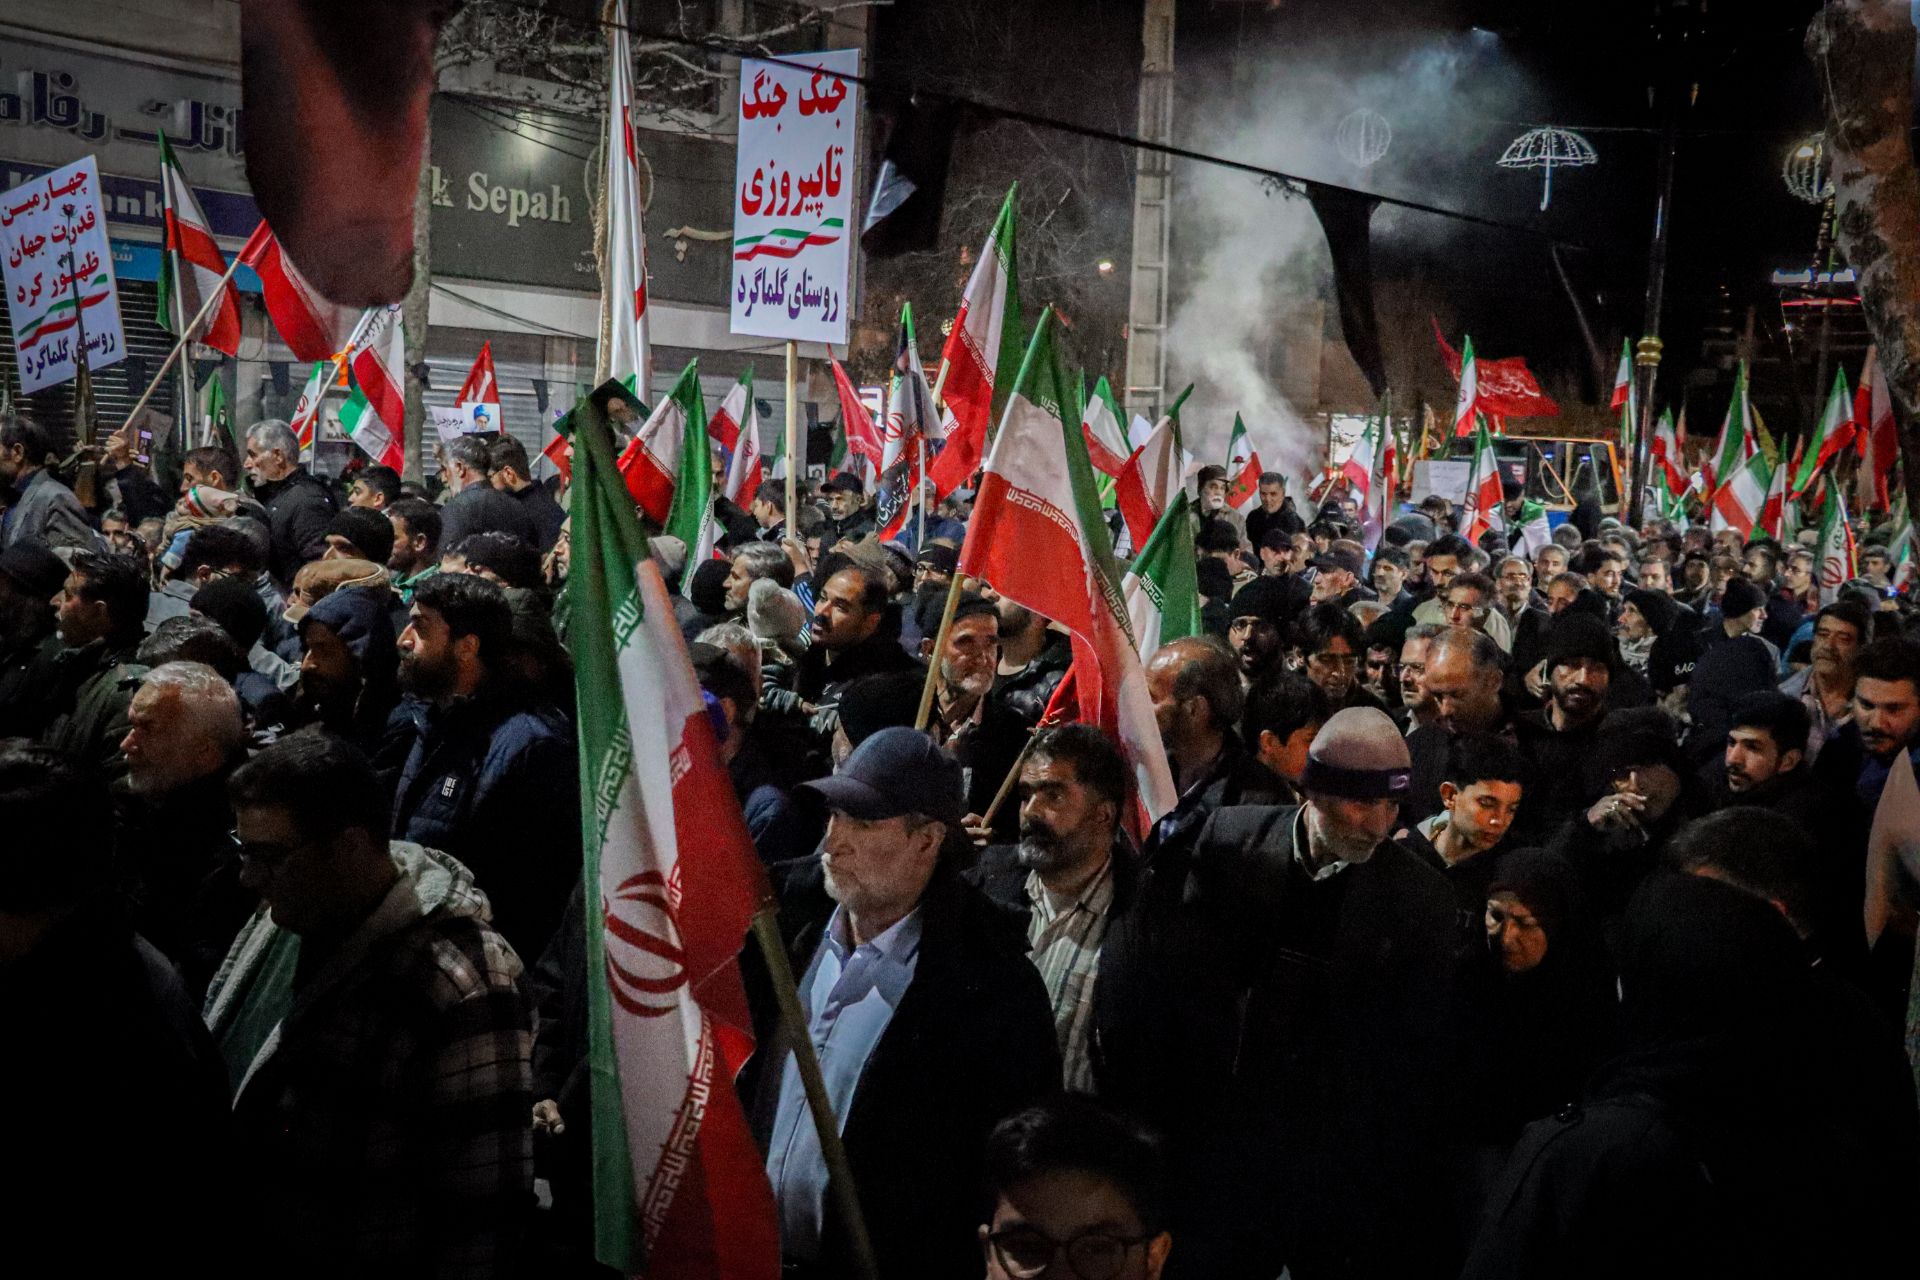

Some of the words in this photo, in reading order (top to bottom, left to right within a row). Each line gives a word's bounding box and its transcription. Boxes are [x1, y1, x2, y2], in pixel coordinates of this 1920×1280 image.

[742, 68, 788, 133] جنگ
[799, 63, 848, 129] جنگ
[51, 204, 97, 245] قدرت
[468, 171, 572, 228] Sepah
[9, 232, 47, 268] جهان
[51, 251, 101, 298] ظهور
[16, 271, 44, 307] کرد
[788, 267, 839, 322] روستای
